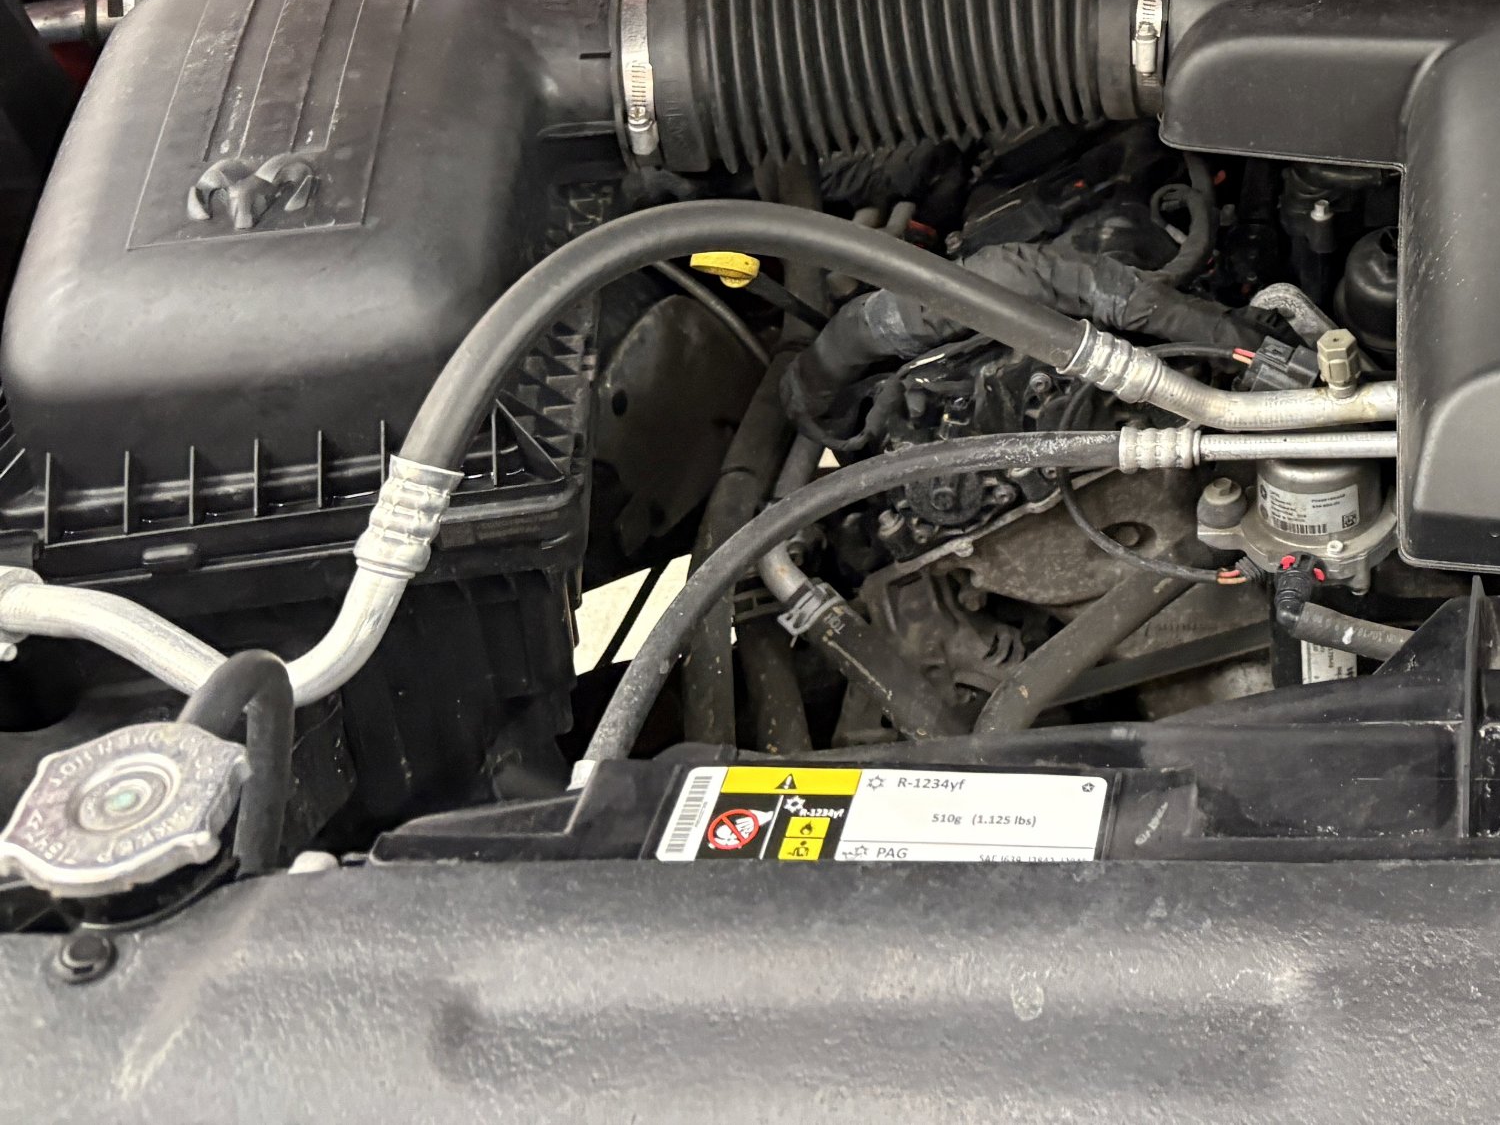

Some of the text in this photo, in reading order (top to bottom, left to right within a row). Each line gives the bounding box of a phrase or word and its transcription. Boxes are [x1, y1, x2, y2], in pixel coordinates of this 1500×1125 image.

[897, 777, 966, 792] R-1234yf
[931, 813, 1037, 828] 510g (1.125 lbs)
[876, 847, 909, 859] PAG
